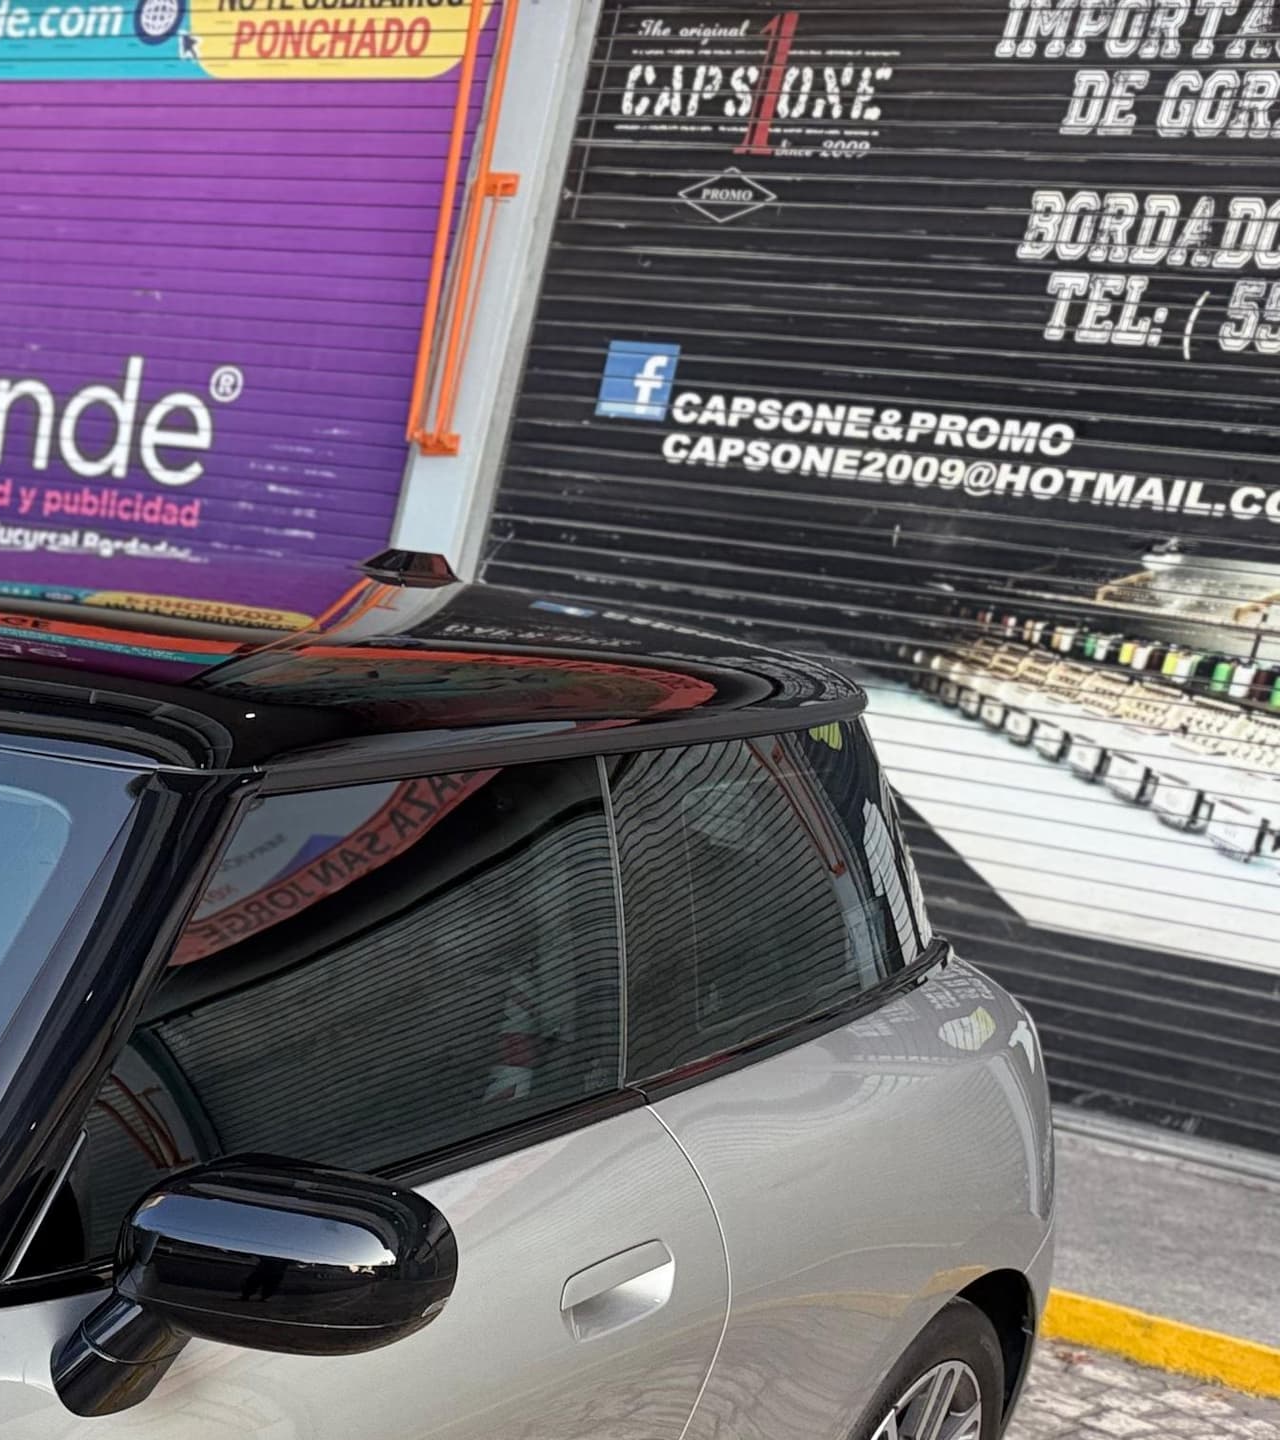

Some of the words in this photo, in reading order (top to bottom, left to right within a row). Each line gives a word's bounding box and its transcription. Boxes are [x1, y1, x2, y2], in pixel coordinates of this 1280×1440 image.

[232, 17, 432, 59] PONCHADO
[638, 19, 672, 37] The
[678, 19, 751, 46] original
[994, 0, 1280, 58] IMPORTA
[1059, 69, 1150, 136] DE
[1156, 69, 1280, 138] GOR
[819, 140, 872, 158] 2009
[701, 188, 753, 201] PROMO
[1043, 271, 1168, 347] TEL:
[671, 392, 1076, 456] CAPSONE&PROMO
[18, 485, 37, 512] y
[43, 485, 201, 528] publicidad
[82, 531, 194, 559] Bordad
